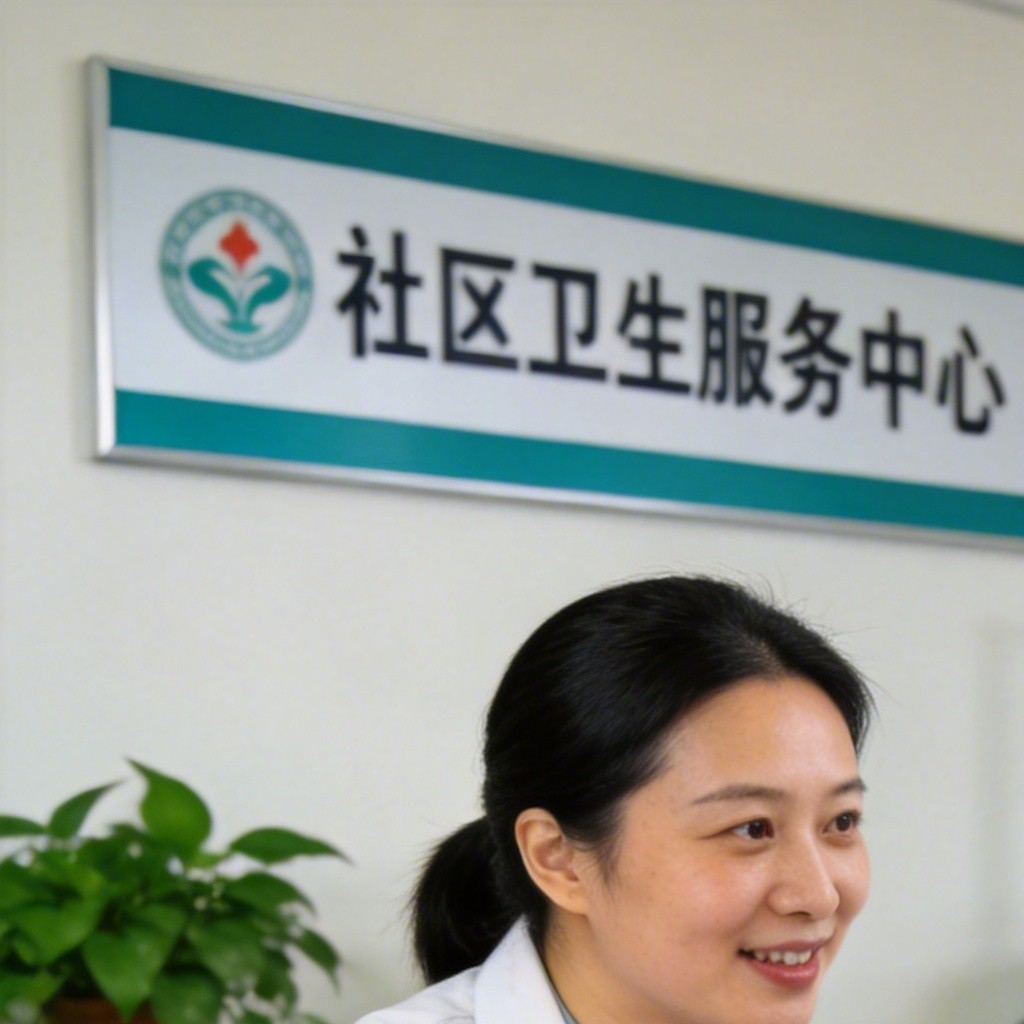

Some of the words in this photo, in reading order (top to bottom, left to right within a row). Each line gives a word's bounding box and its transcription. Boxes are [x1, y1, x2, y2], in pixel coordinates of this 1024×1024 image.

[337, 227, 1005, 436] 社区卫生服务中心
